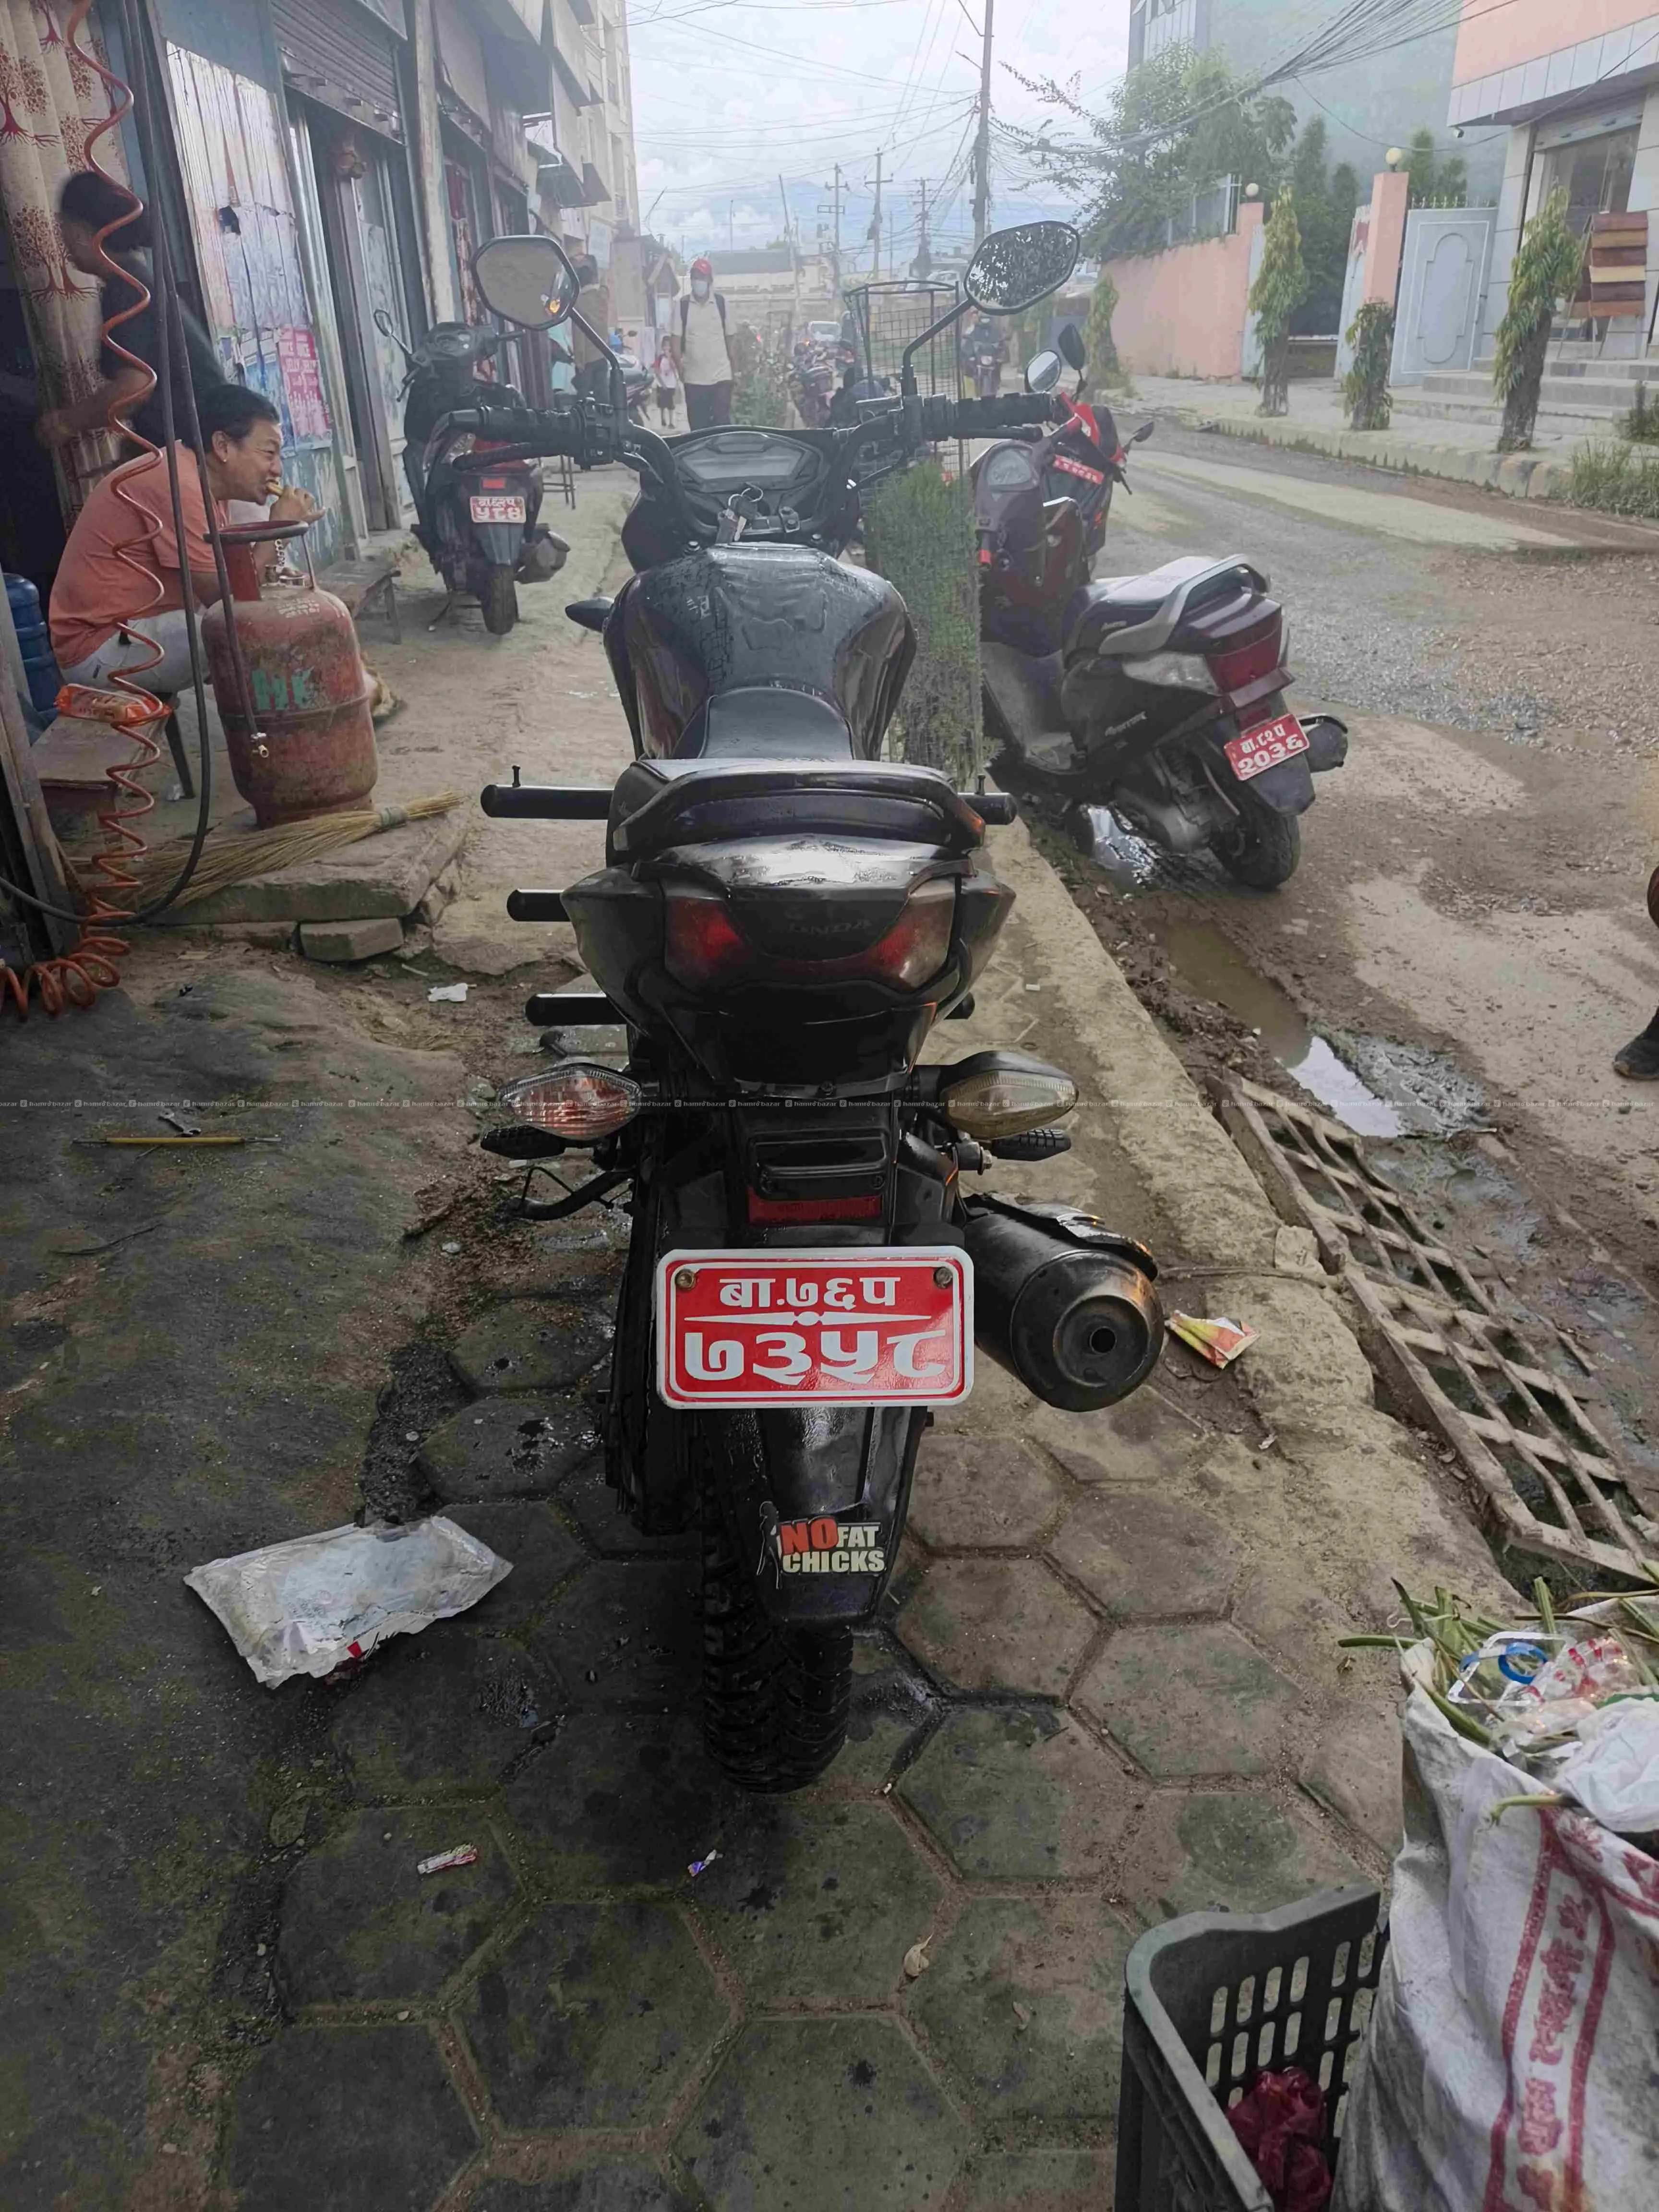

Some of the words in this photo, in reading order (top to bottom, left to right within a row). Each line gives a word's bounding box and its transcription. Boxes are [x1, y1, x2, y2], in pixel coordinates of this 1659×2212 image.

[1238, 734, 1304, 773] २०३६
[720, 1276, 901, 1310] बा.७६प
[685, 1330, 946, 1385] ७३५८
[781, 1518, 839, 1555] NO
[836, 1526, 879, 1548] FAT
[782, 1550, 885, 1573] CHICKS
